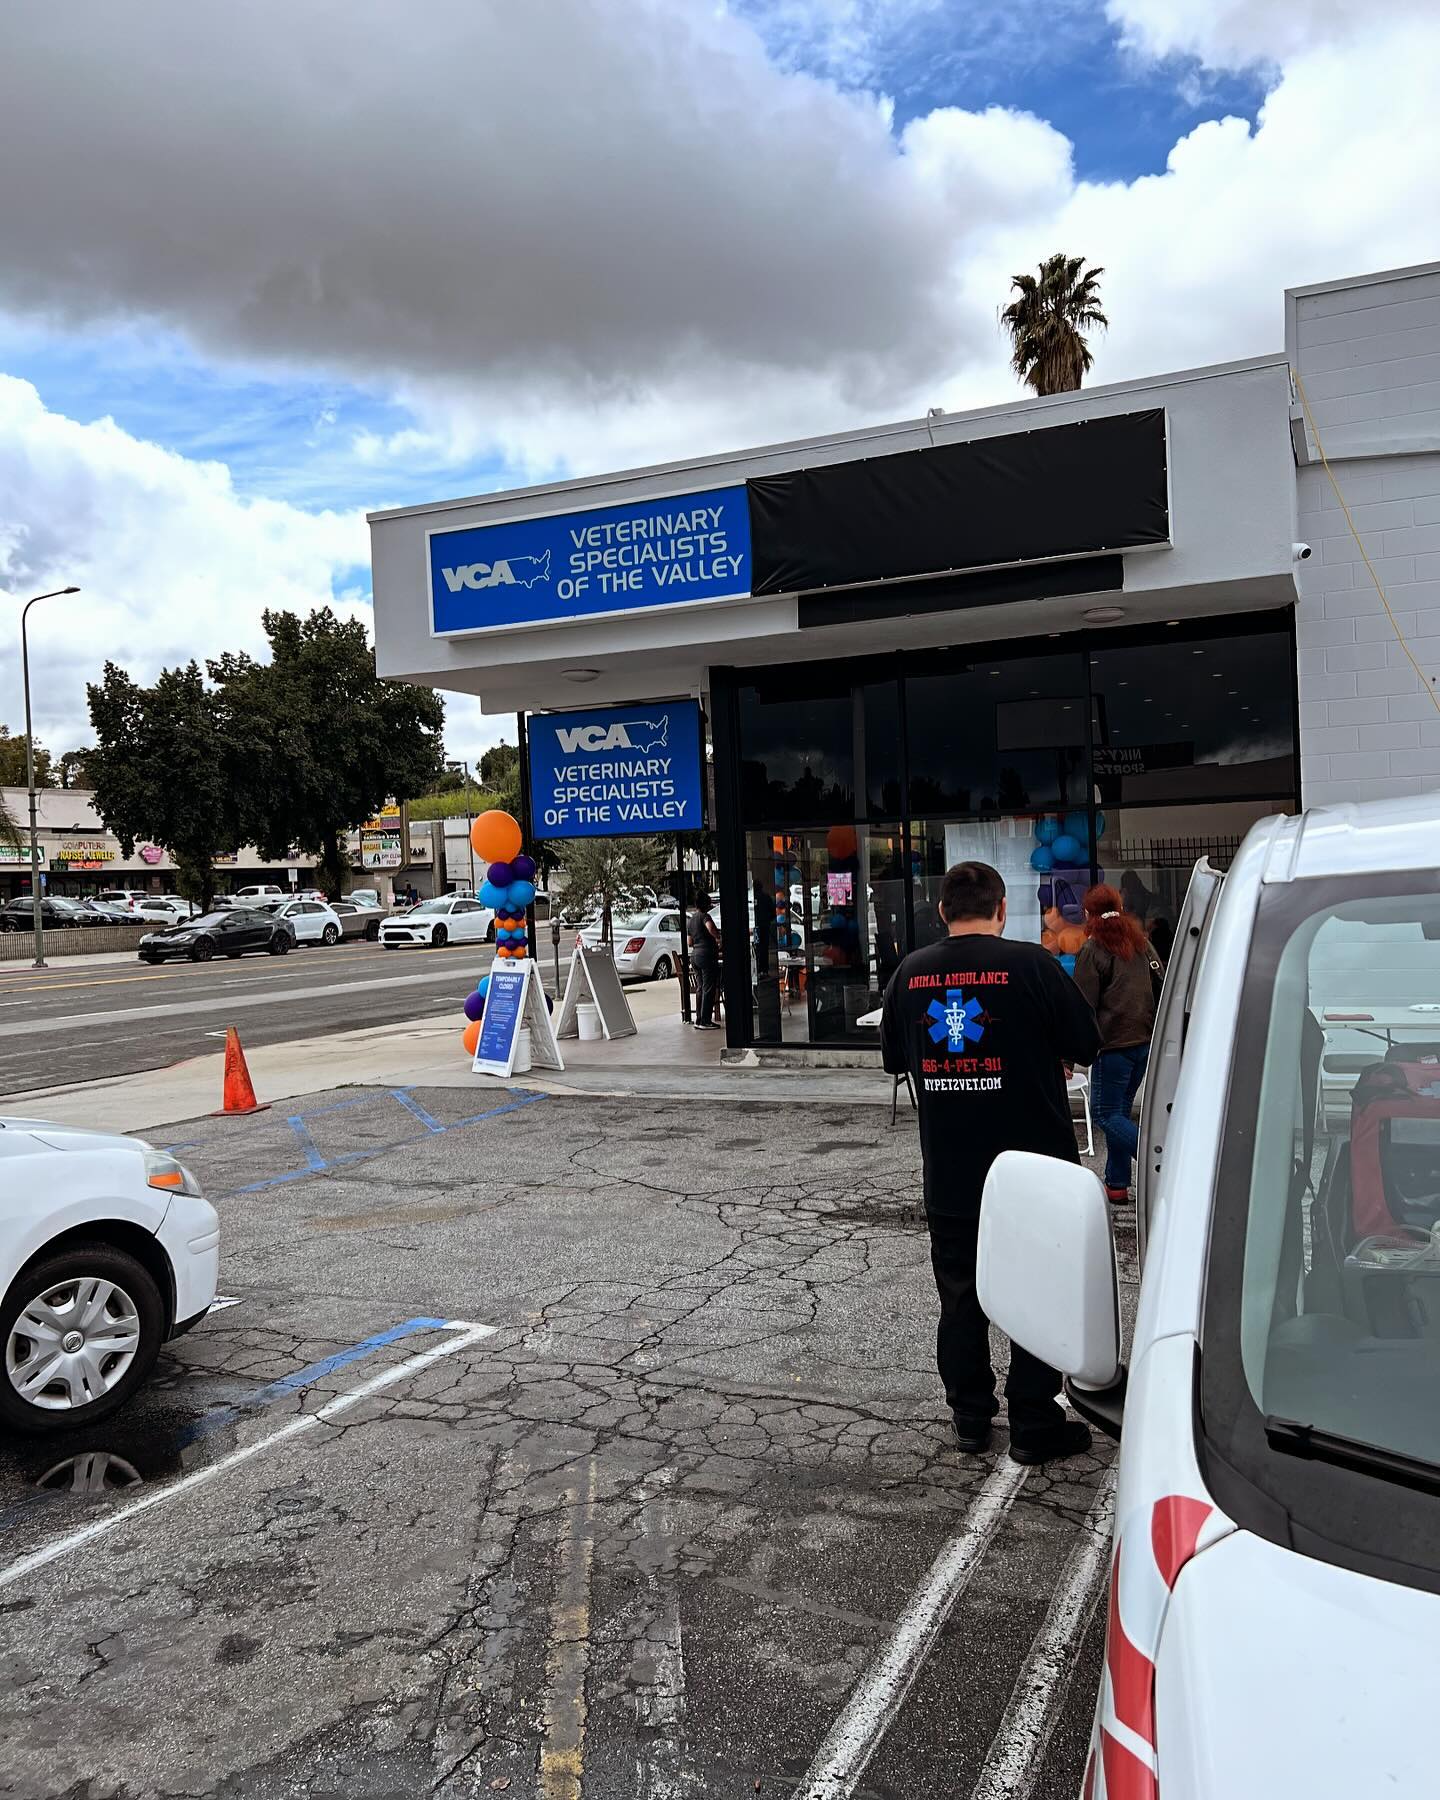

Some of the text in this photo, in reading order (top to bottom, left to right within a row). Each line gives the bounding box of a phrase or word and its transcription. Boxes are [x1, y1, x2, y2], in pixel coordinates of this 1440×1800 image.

[570, 506, 724, 549] VETERINARY
[569, 531, 727, 574] SPECIALISTS
[441, 560, 517, 592] VCA
[557, 554, 744, 600] OF THE VALLEY
[555, 723, 633, 754] VCA
[554, 758, 672, 783] VETERINARY
[553, 779, 675, 804] SPECIALISTS
[544, 800, 688, 825] OF THE VALLEY
[908, 972, 1009, 990] ANIMAL AMBULANCE
